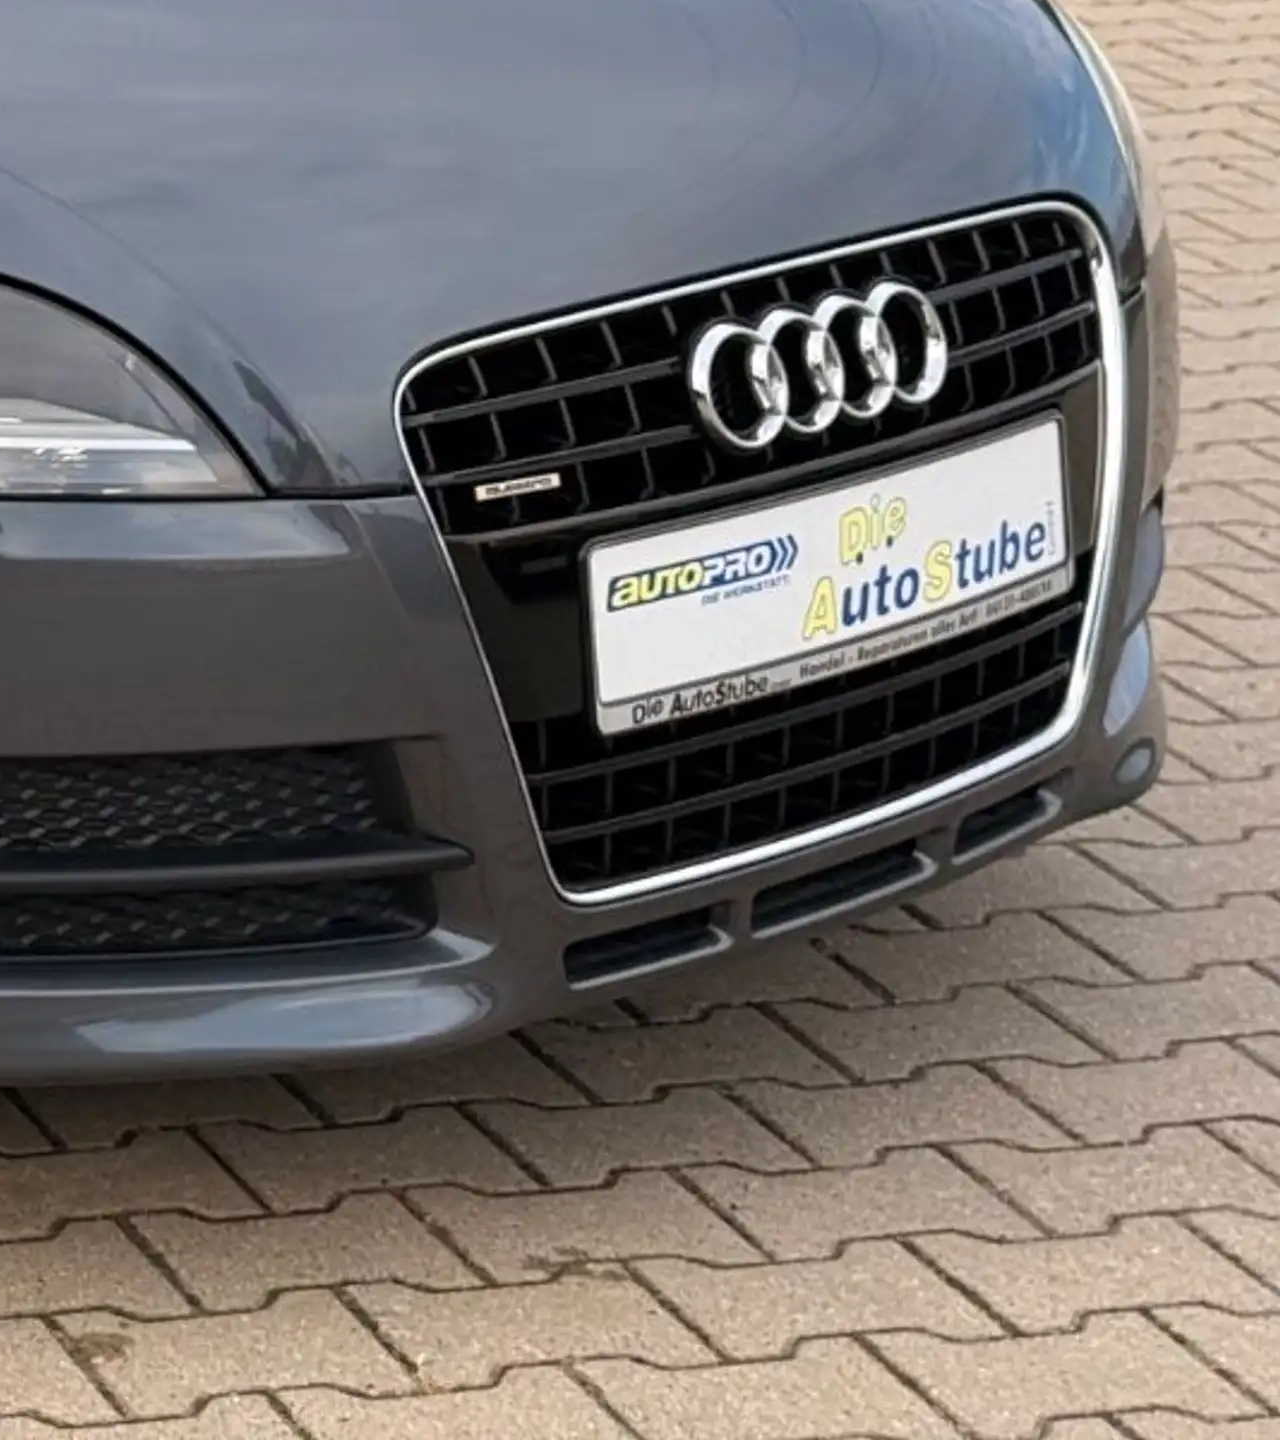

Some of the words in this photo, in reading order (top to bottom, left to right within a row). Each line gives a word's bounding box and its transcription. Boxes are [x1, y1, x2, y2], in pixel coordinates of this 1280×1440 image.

[838, 493, 908, 566] Die
[801, 519, 1047, 640] AutoStube
[631, 695, 665, 725] Die
[669, 674, 770, 717] AutoStube
